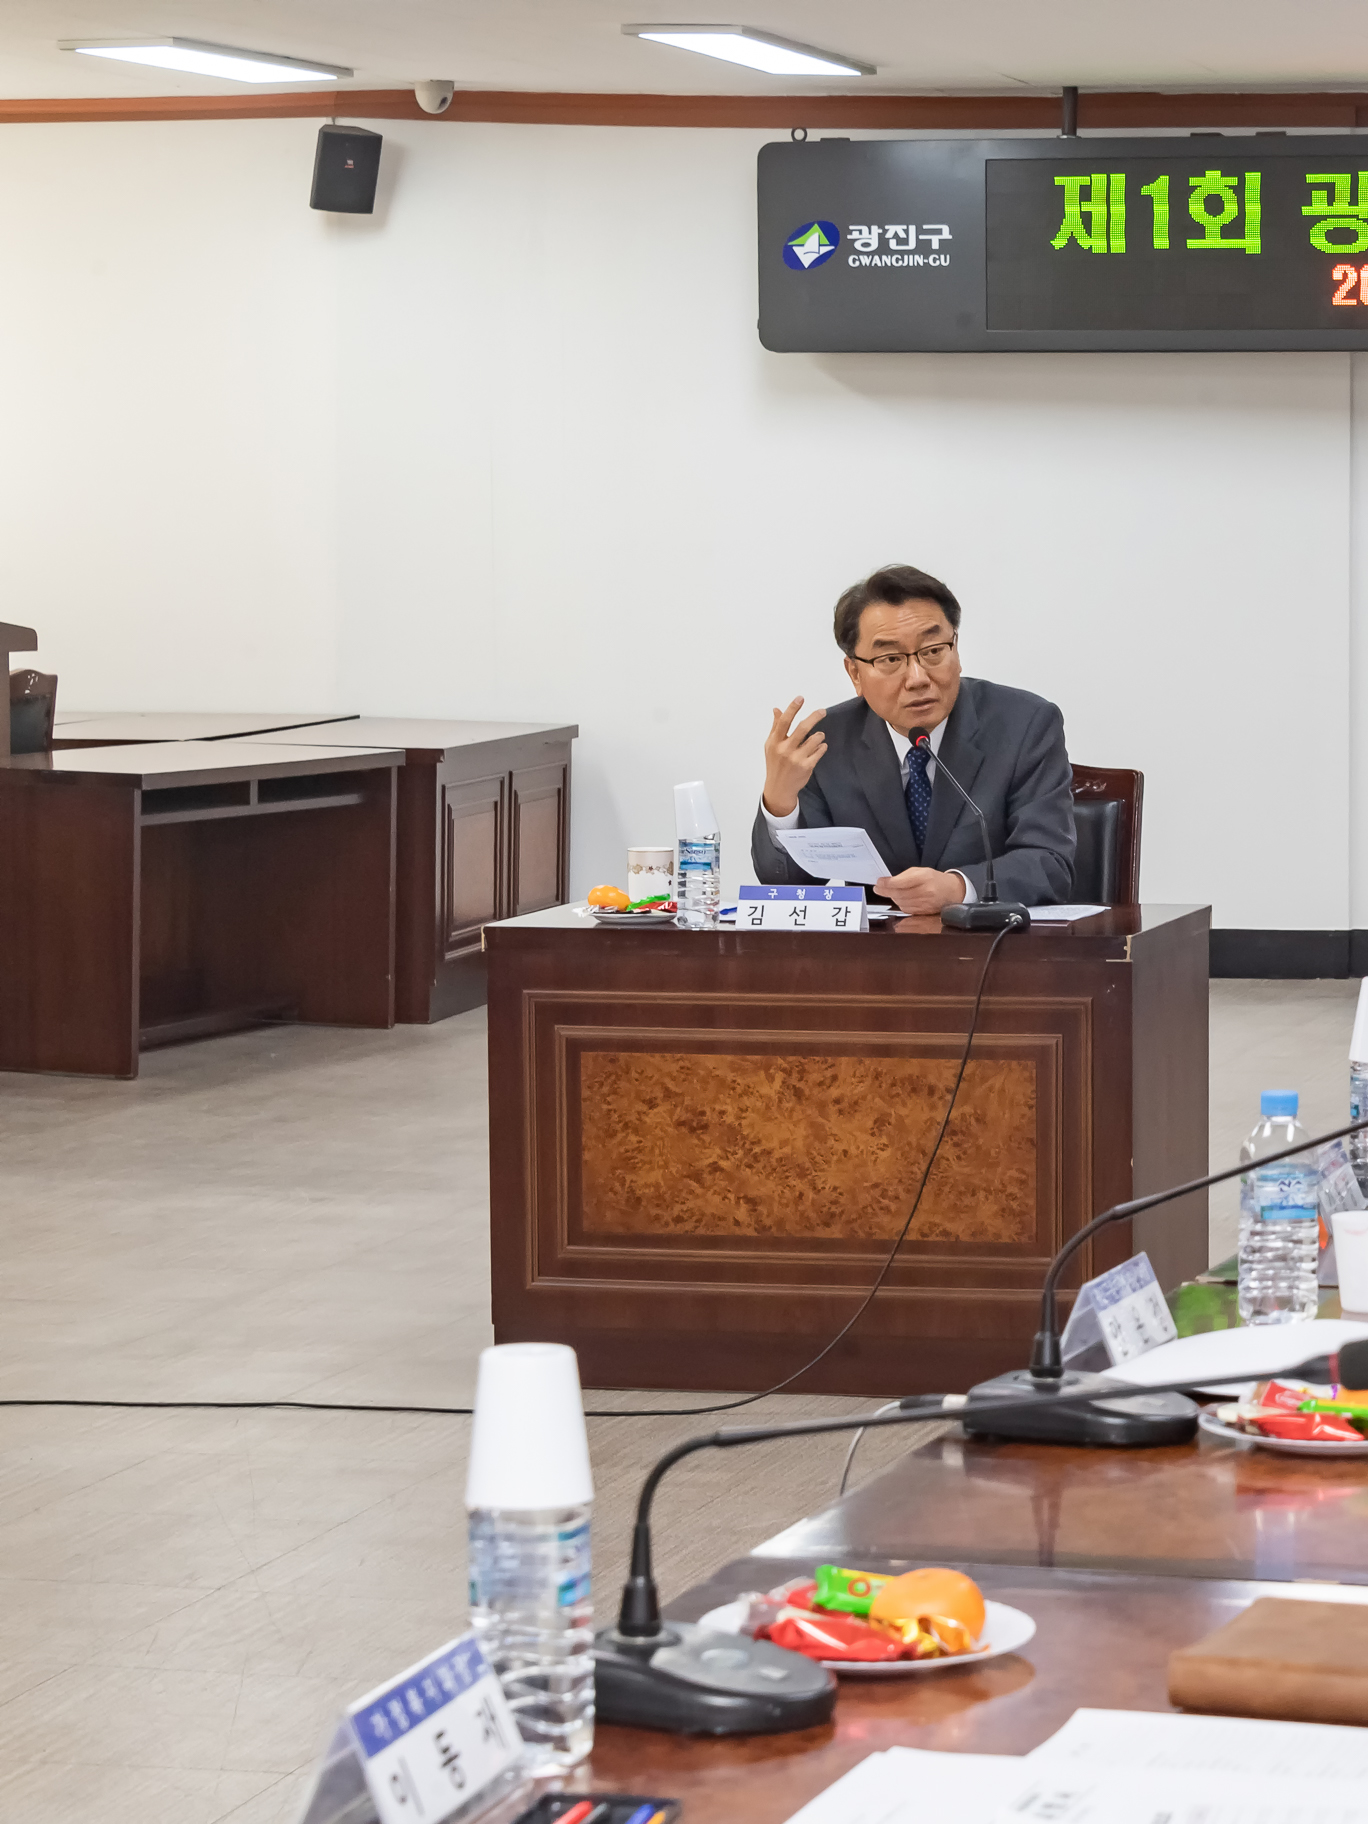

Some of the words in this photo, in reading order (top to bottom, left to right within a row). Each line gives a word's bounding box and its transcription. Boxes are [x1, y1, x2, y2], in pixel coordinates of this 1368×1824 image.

[1050, 171, 1262, 254] 제1회
[846, 224, 953, 252] 광진구
[847, 254, 951, 268] GWANGJIN-GU
